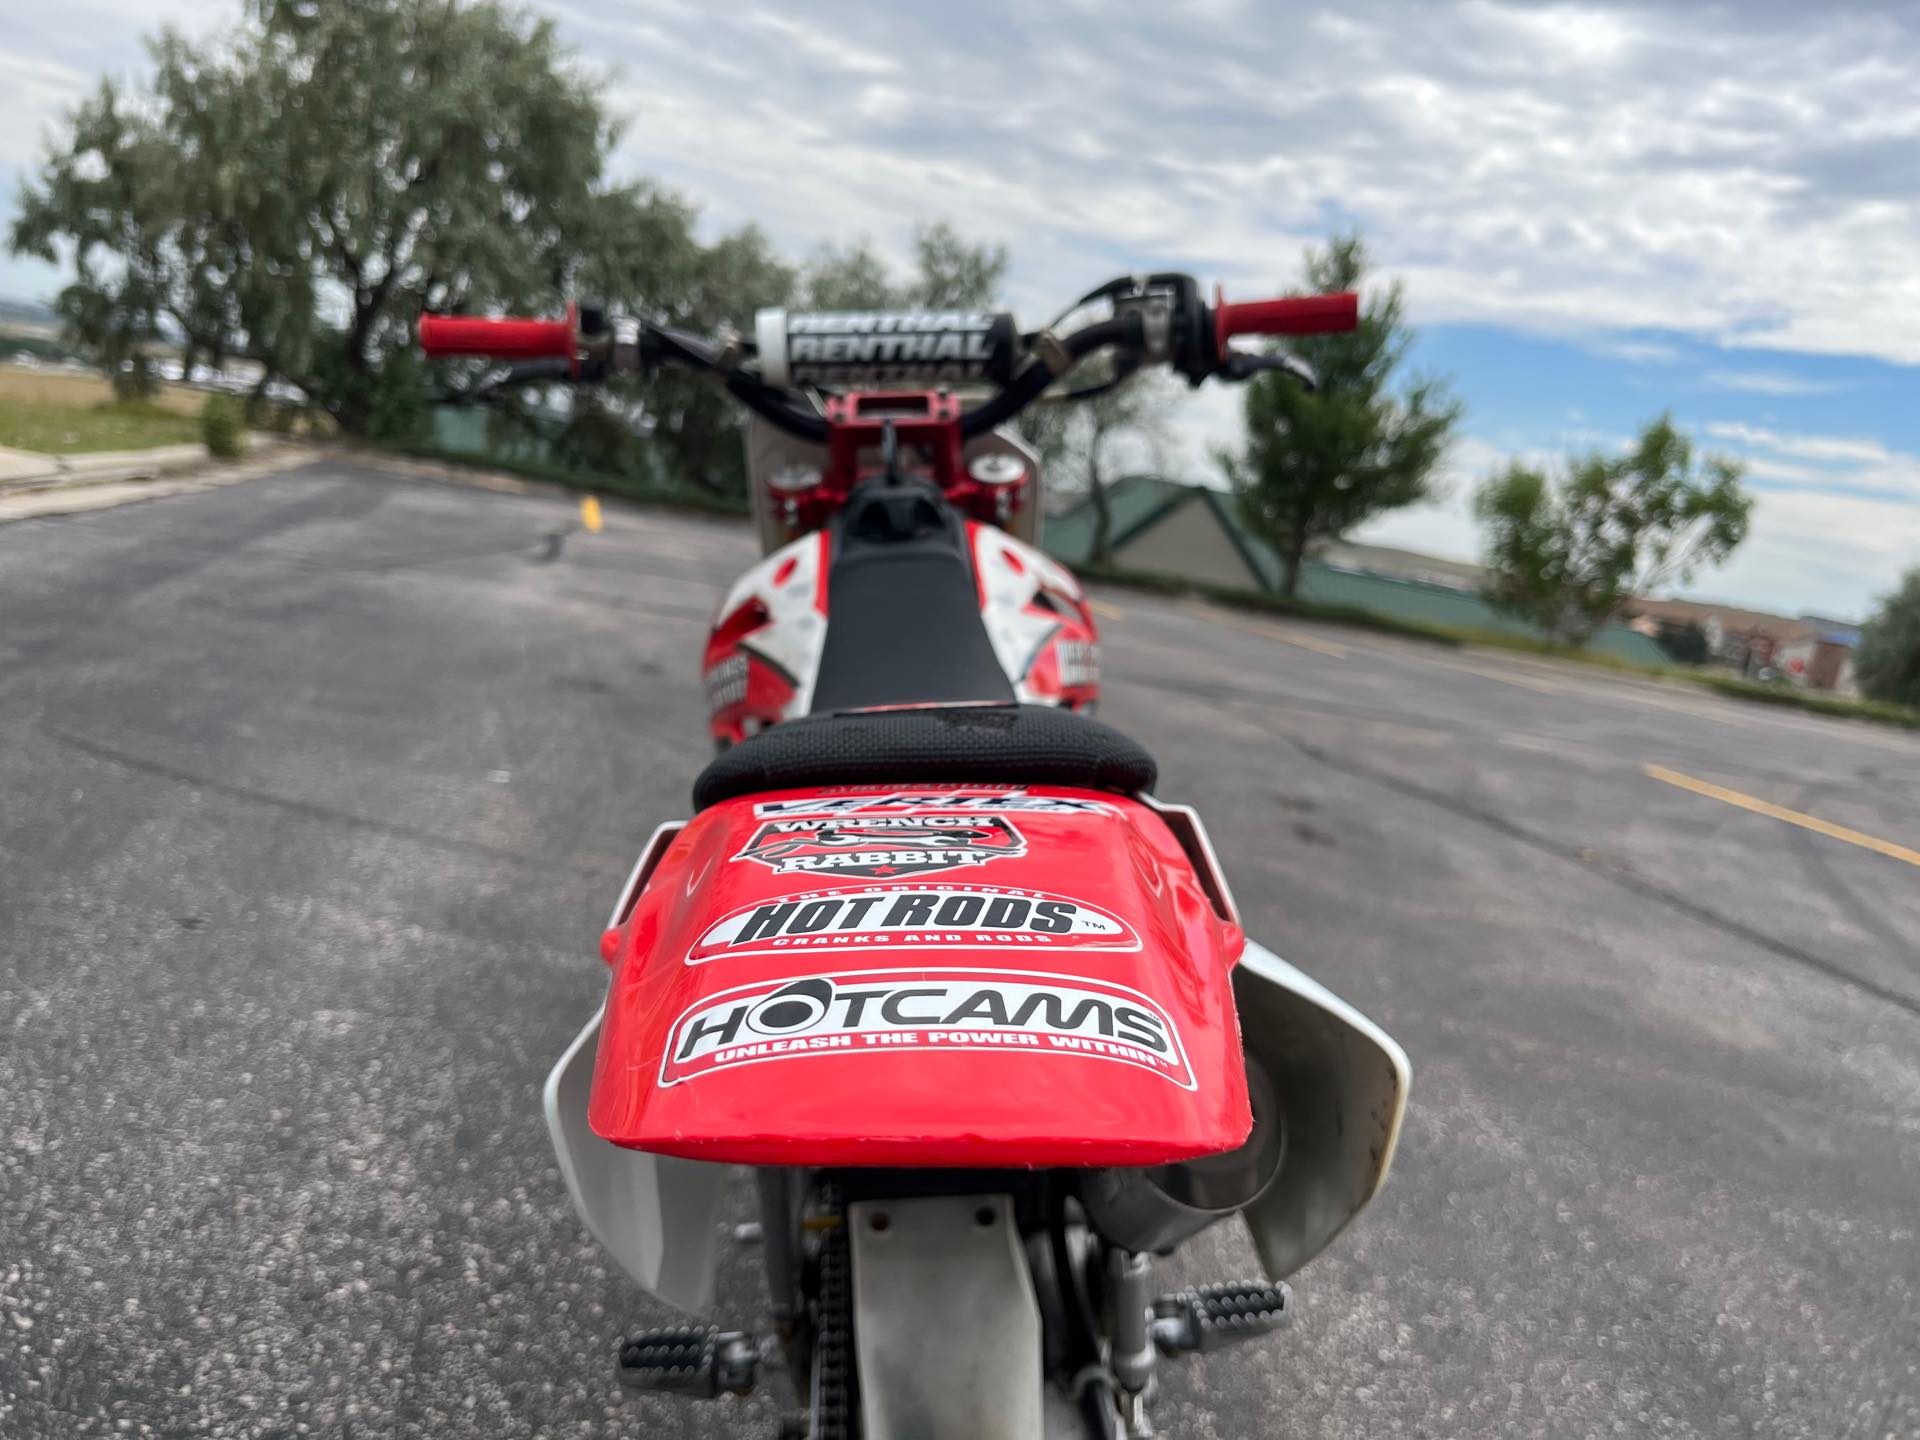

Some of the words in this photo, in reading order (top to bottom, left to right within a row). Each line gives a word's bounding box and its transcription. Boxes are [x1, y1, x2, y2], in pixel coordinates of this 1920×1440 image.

[791, 334, 994, 360] RENTHAL
[774, 815, 994, 833] WRENCH
[780, 850, 986, 872] RABBIT
[774, 890, 843, 903] THE
[863, 885, 1047, 899] ORIGINAL
[731, 896, 887, 945] HOT
[880, 894, 1078, 934] RODS
[772, 935, 890, 946] CRANKS
[903, 934, 962, 942] AND
[975, 934, 1053, 943] RODS
[676, 978, 1168, 1053] HOTCAMS
[714, 1034, 851, 1063] UNLEASH
[861, 1032, 918, 1045] THE
[928, 1032, 1040, 1046] POWER
[1048, 1035, 1157, 1067] WITHIN
